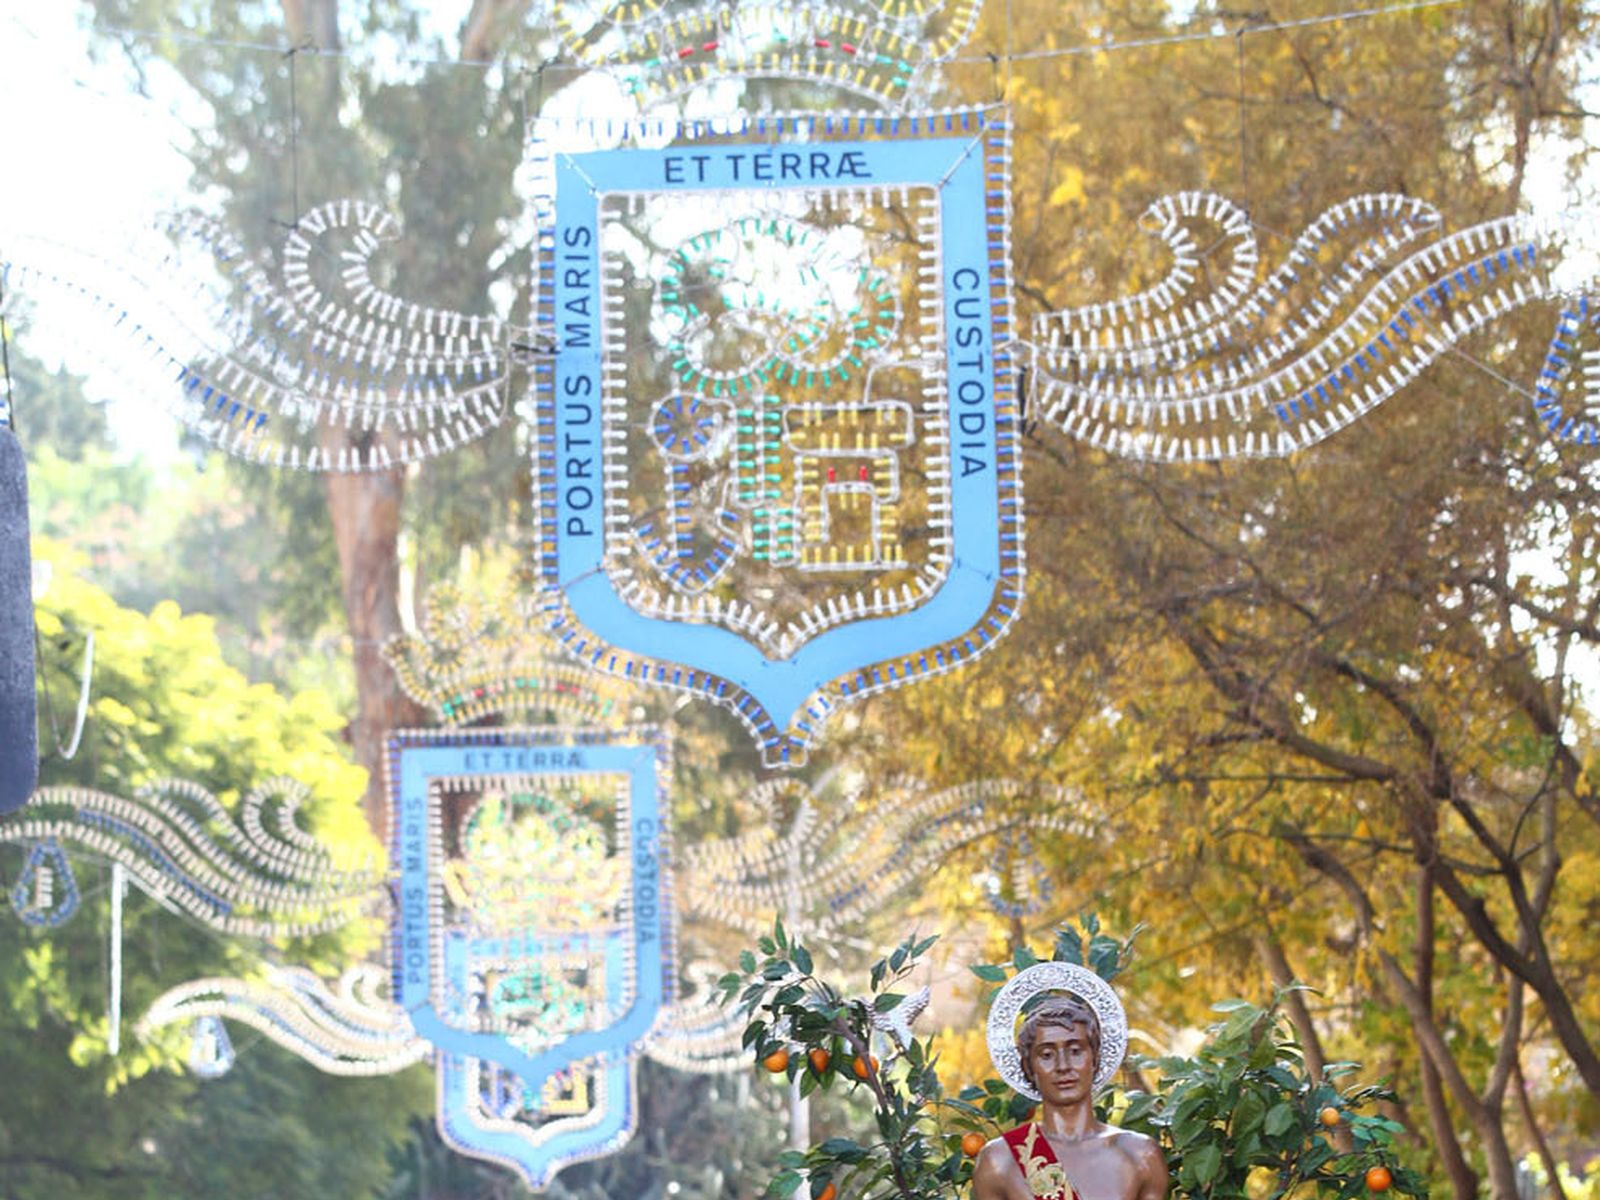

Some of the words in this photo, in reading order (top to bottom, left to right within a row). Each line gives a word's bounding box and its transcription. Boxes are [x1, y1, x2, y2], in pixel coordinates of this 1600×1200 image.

[664, 155, 709, 184] ET
[726, 151, 872, 181] TERRÆ
[564, 225, 592, 348] MARIS
[953, 268, 987, 477] CUSTODIA
[567, 374, 593, 537] PORTUS
[464, 752, 491, 770] ET
[406, 797, 424, 872] MARIS
[636, 818, 656, 943] CUSTODIA
[407, 888, 424, 984] PORTUS
